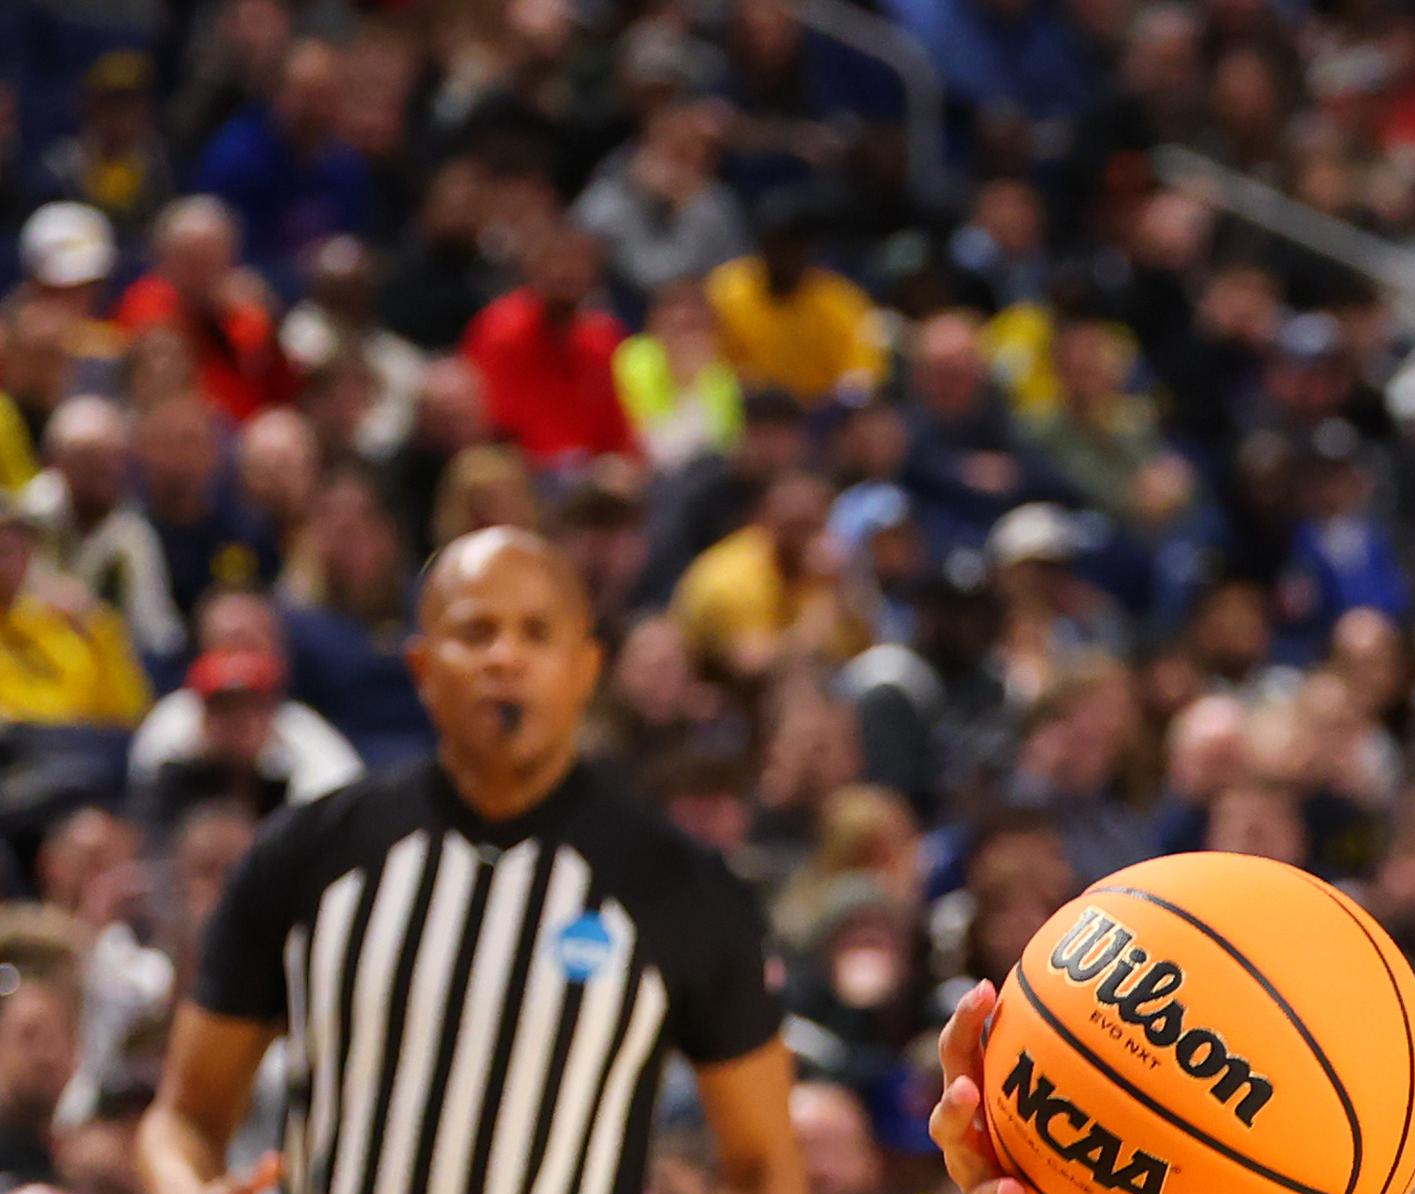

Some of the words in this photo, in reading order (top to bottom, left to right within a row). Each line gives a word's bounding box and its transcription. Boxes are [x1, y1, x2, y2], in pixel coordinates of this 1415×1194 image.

[1048, 905, 1274, 1131] Wilson
[1089, 1009, 1123, 1040] EVO
[1124, 1038, 1162, 1071] NXT
